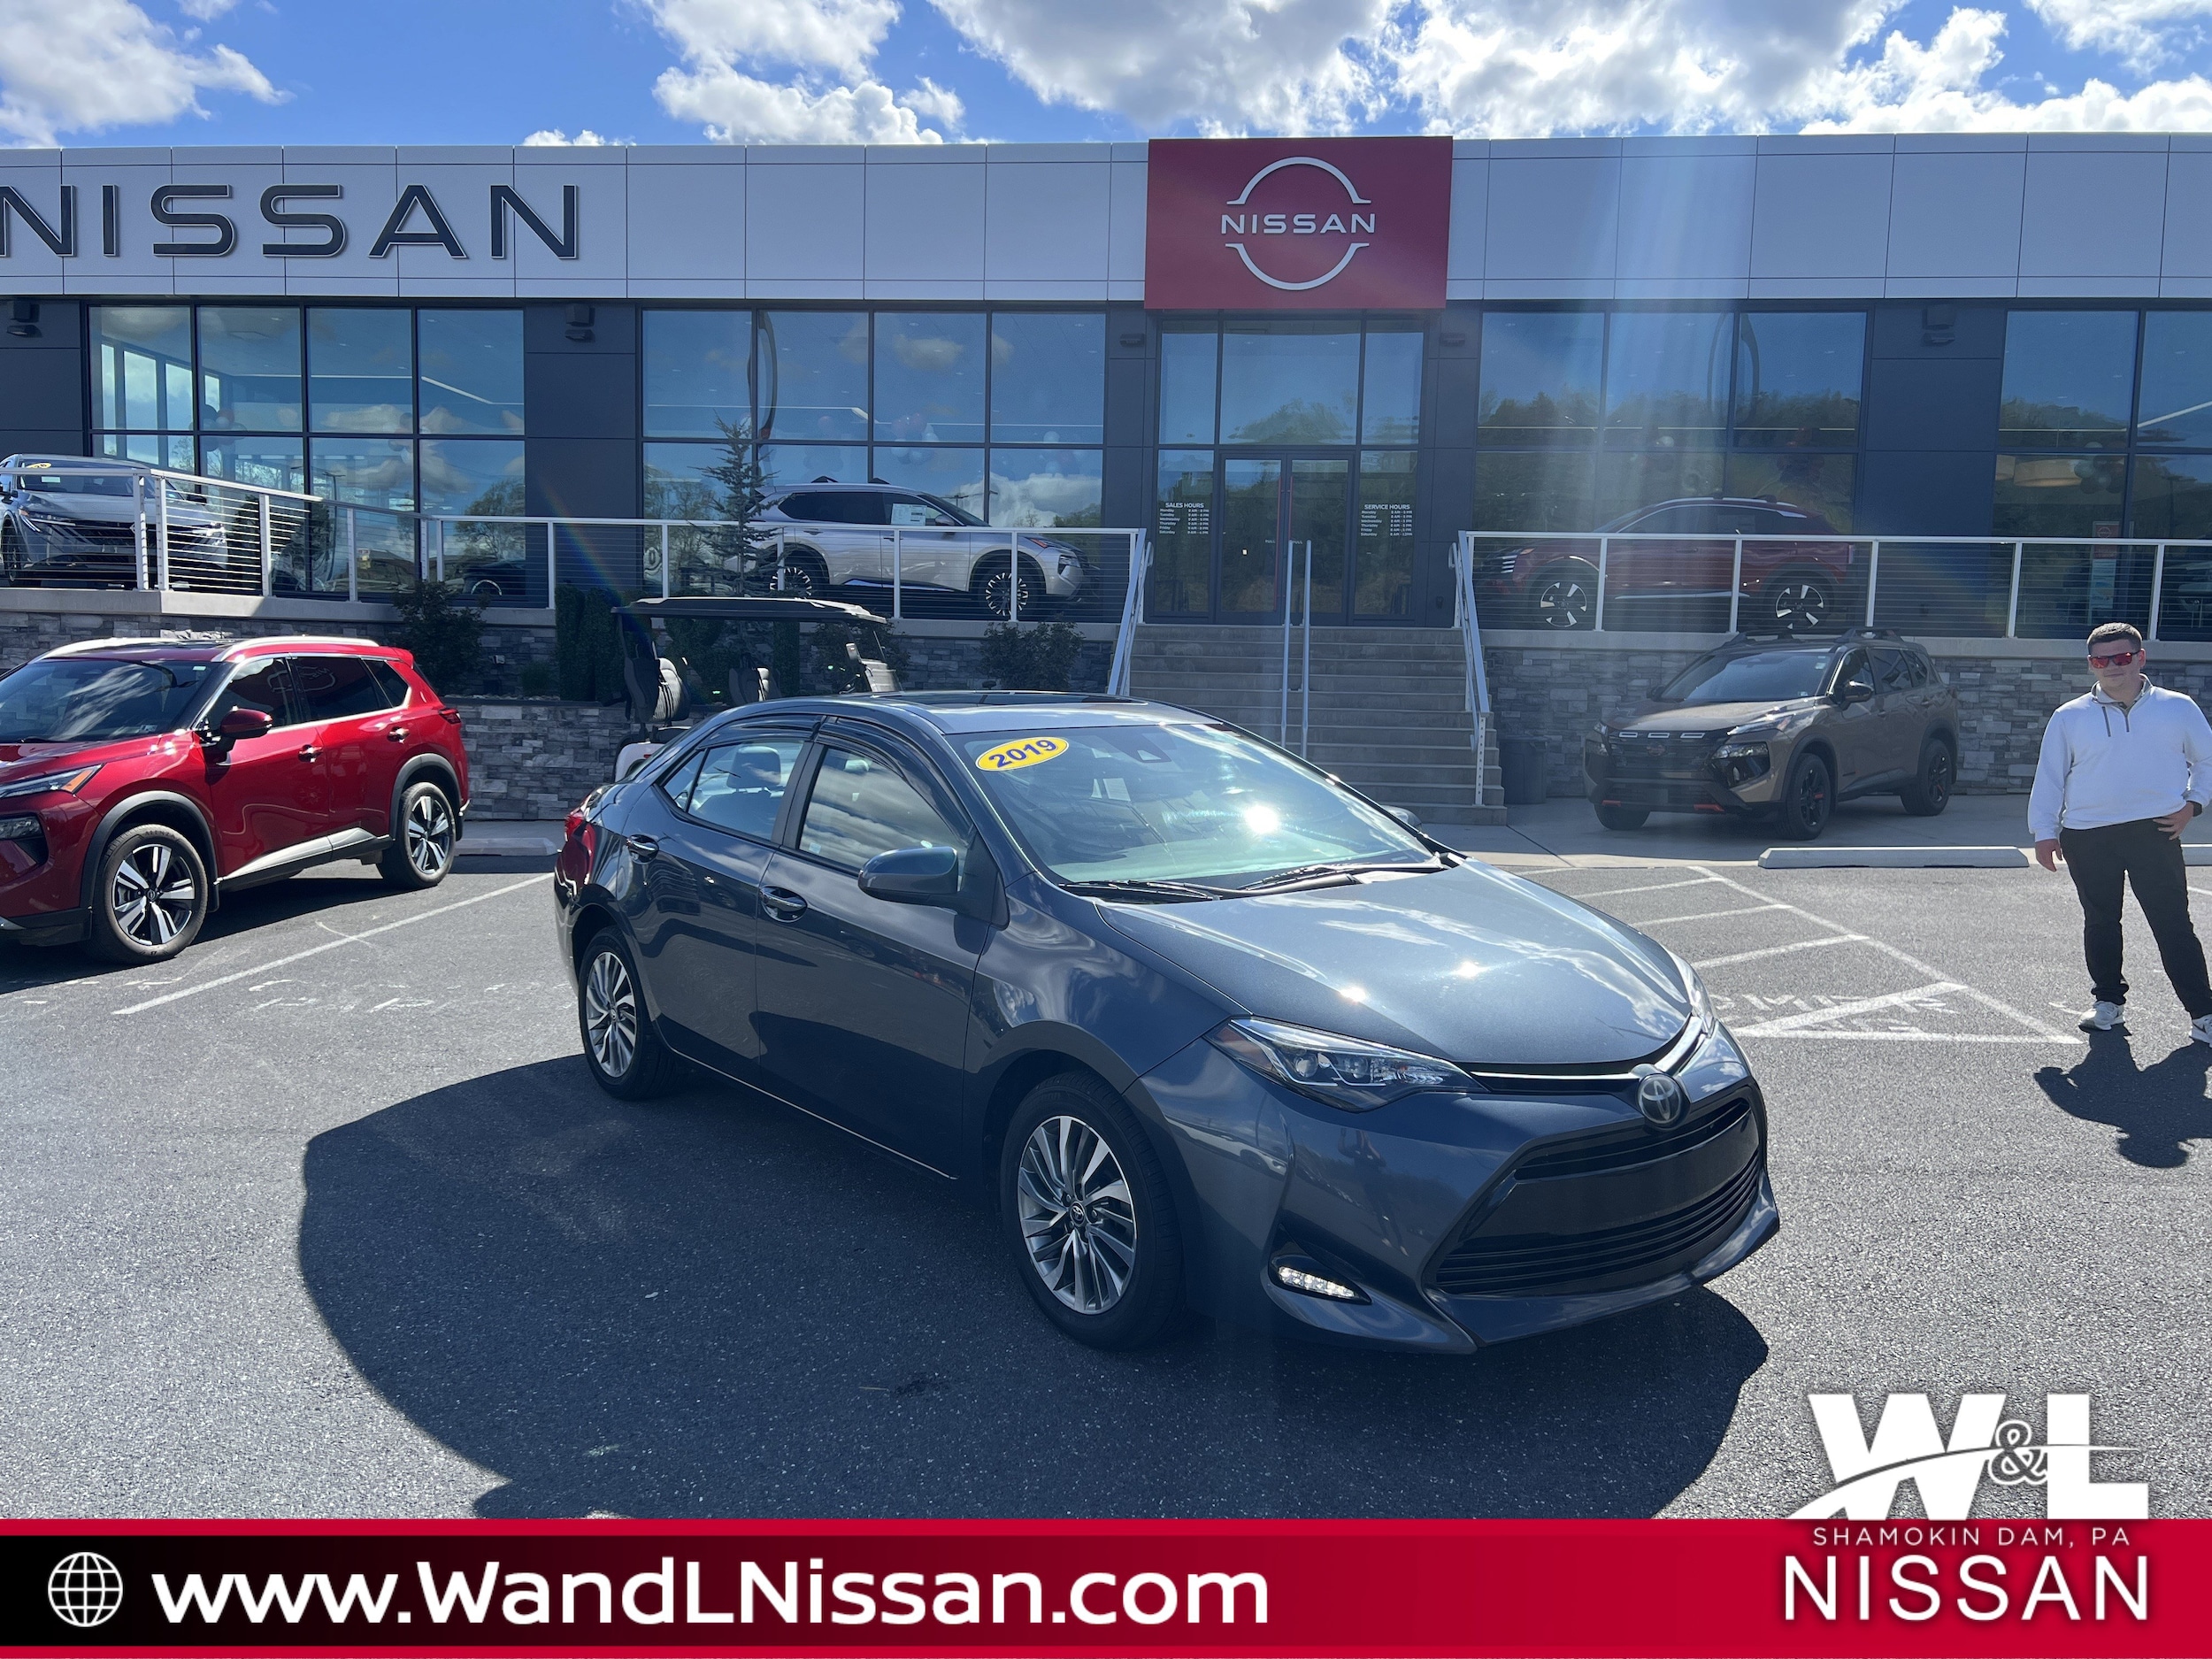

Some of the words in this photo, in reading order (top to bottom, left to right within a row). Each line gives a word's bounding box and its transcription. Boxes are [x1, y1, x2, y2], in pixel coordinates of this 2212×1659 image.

[0, 184, 578, 258] NISSAN
[1221, 213, 1375, 234] NISSAN
[988, 740, 1056, 768] 2019
